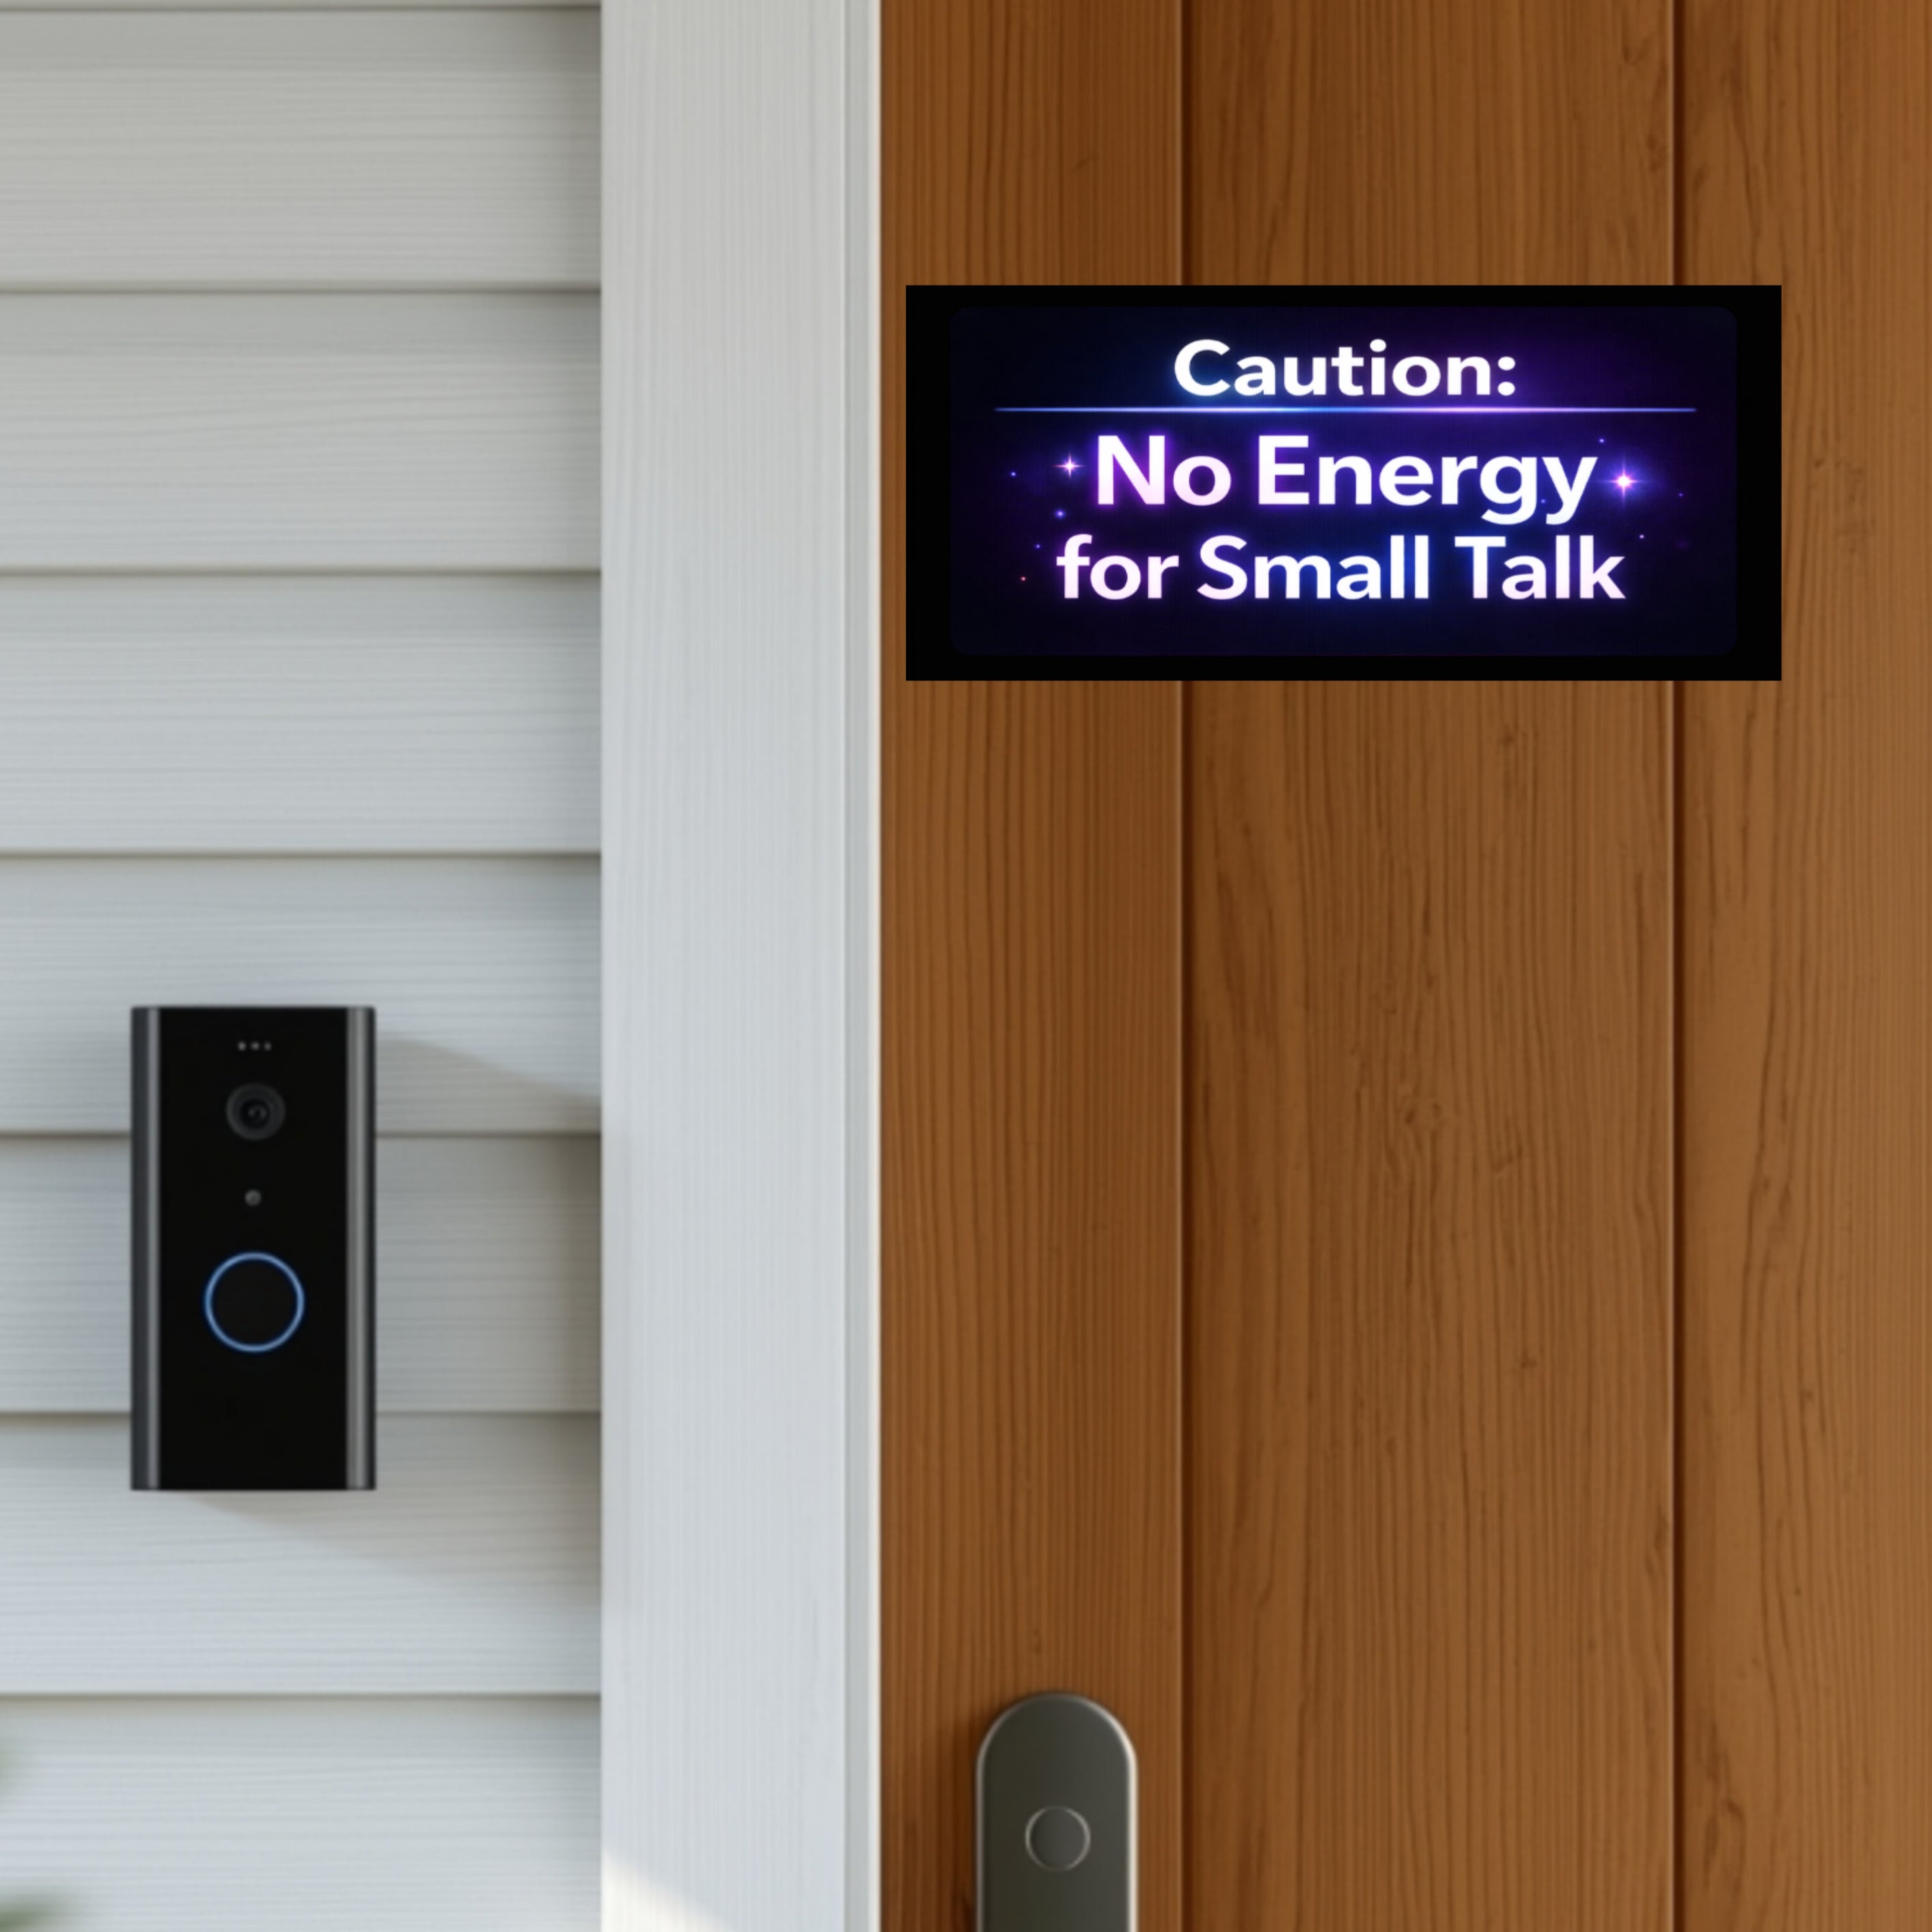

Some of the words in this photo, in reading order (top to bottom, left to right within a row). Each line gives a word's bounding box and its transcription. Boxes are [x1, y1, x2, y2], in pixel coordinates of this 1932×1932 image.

[1174, 338, 1516, 397] Caution:
[1096, 434, 1232, 506] No
[1258, 434, 1598, 525] Energy
[1056, 534, 1179, 600] for
[1197, 535, 1429, 600] Small
[1454, 535, 1625, 600] Talk
